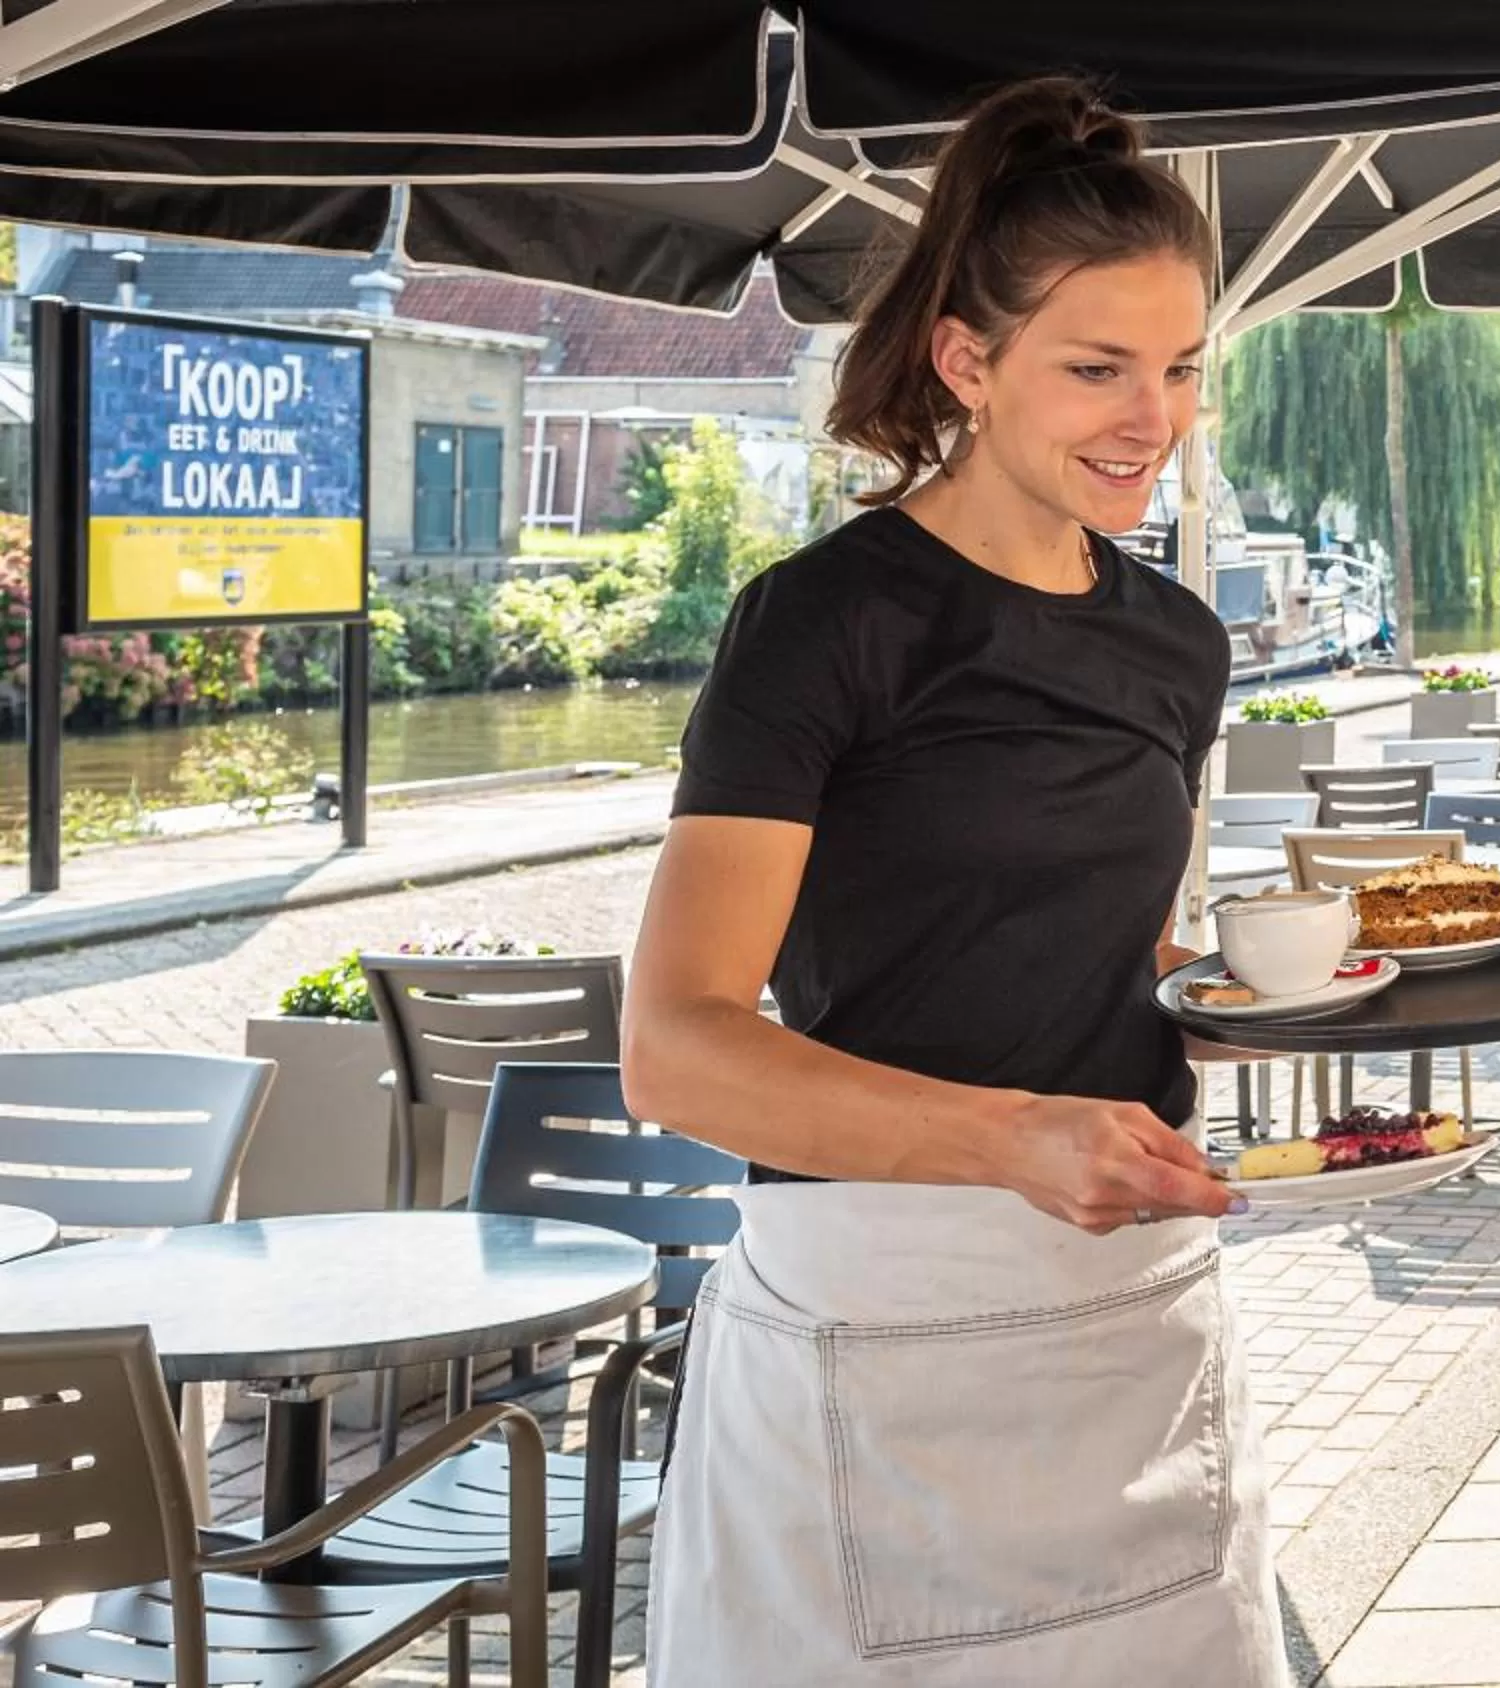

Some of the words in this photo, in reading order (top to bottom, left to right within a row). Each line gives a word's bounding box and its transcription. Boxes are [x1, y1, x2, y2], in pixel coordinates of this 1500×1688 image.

[179, 358, 289, 421] KOOP
[169, 424, 207, 451] EET
[215, 426, 231, 453] &
[237, 427, 297, 454] DRINK
